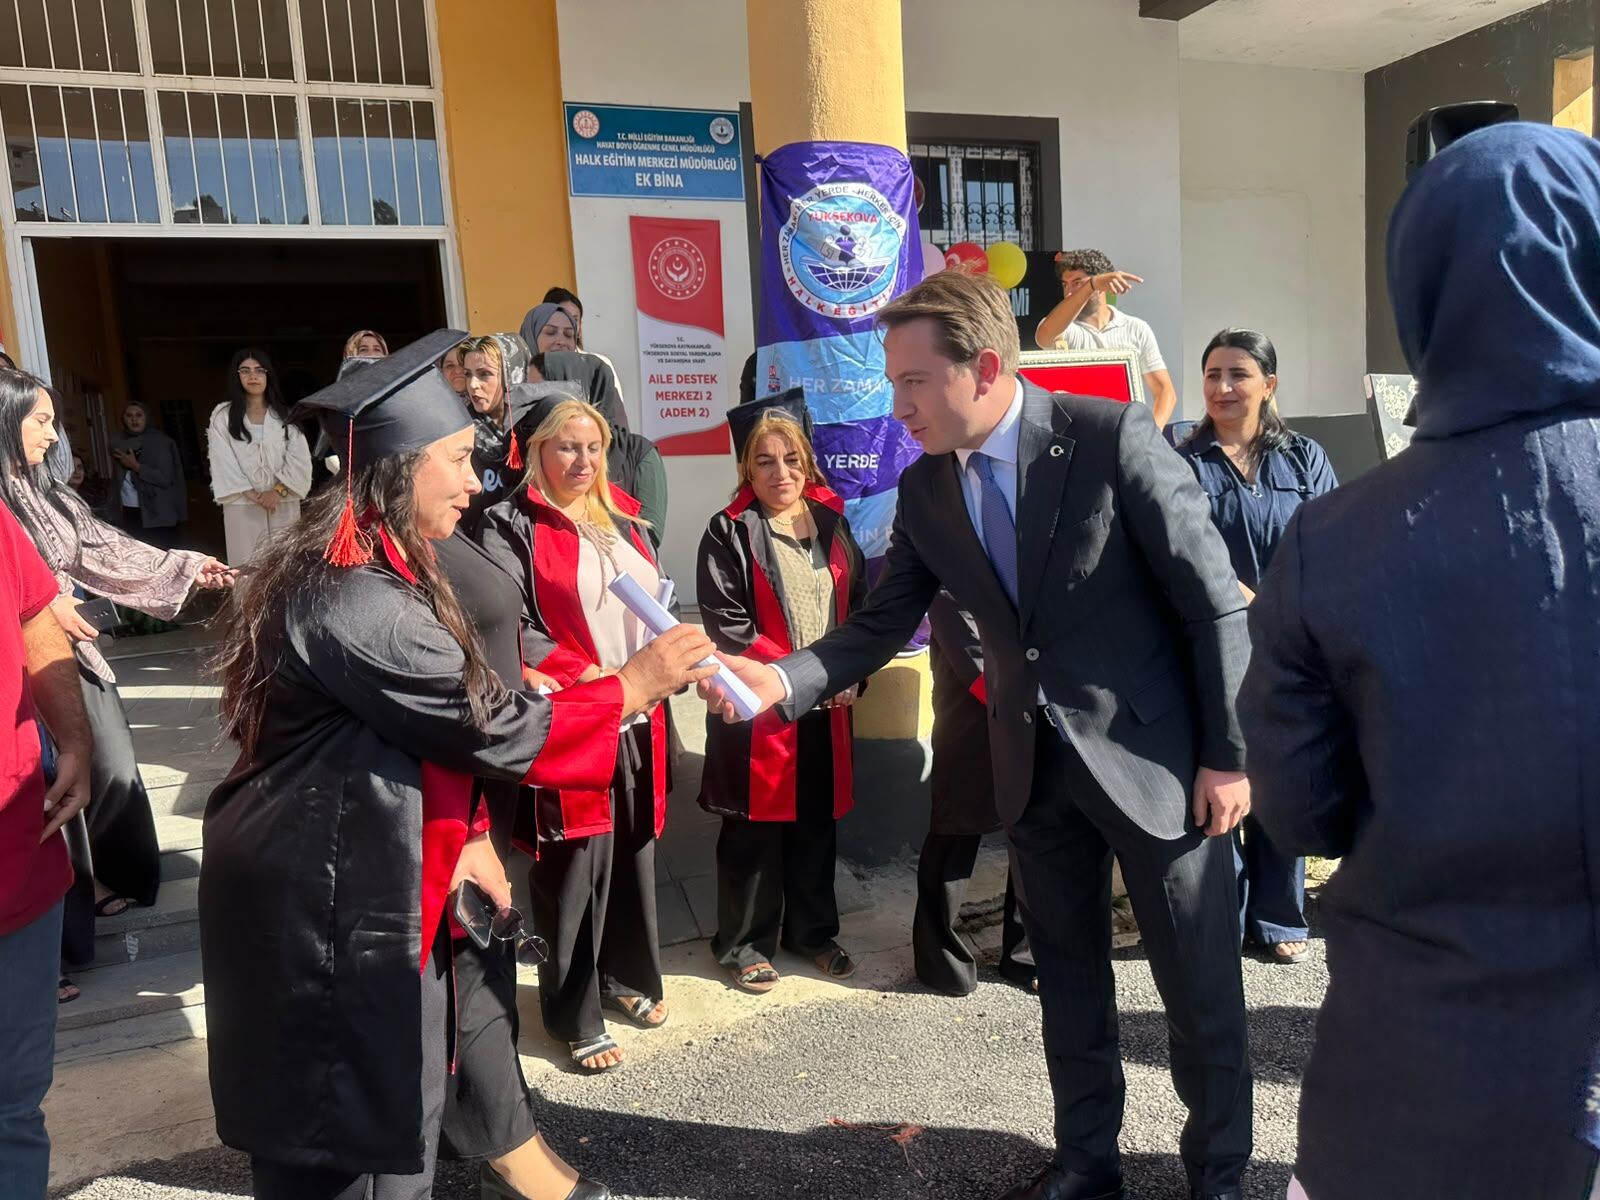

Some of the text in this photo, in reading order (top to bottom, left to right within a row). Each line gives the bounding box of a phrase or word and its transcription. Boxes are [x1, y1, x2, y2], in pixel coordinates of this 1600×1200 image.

[596, 141, 615, 149] HAYAT
[575, 153, 737, 171] HALK EĞİTİM MERKEZİ MÜDÜRLÜĞÜ
[635, 171, 684, 188] EK BİNA
[788, 276, 826, 313] HALK
[648, 374, 718, 384] AİLE DESTEK
[705, 391, 713, 401] 2
[660, 407, 710, 419] (ADEM 2)
[824, 454, 880, 469] YERDE
